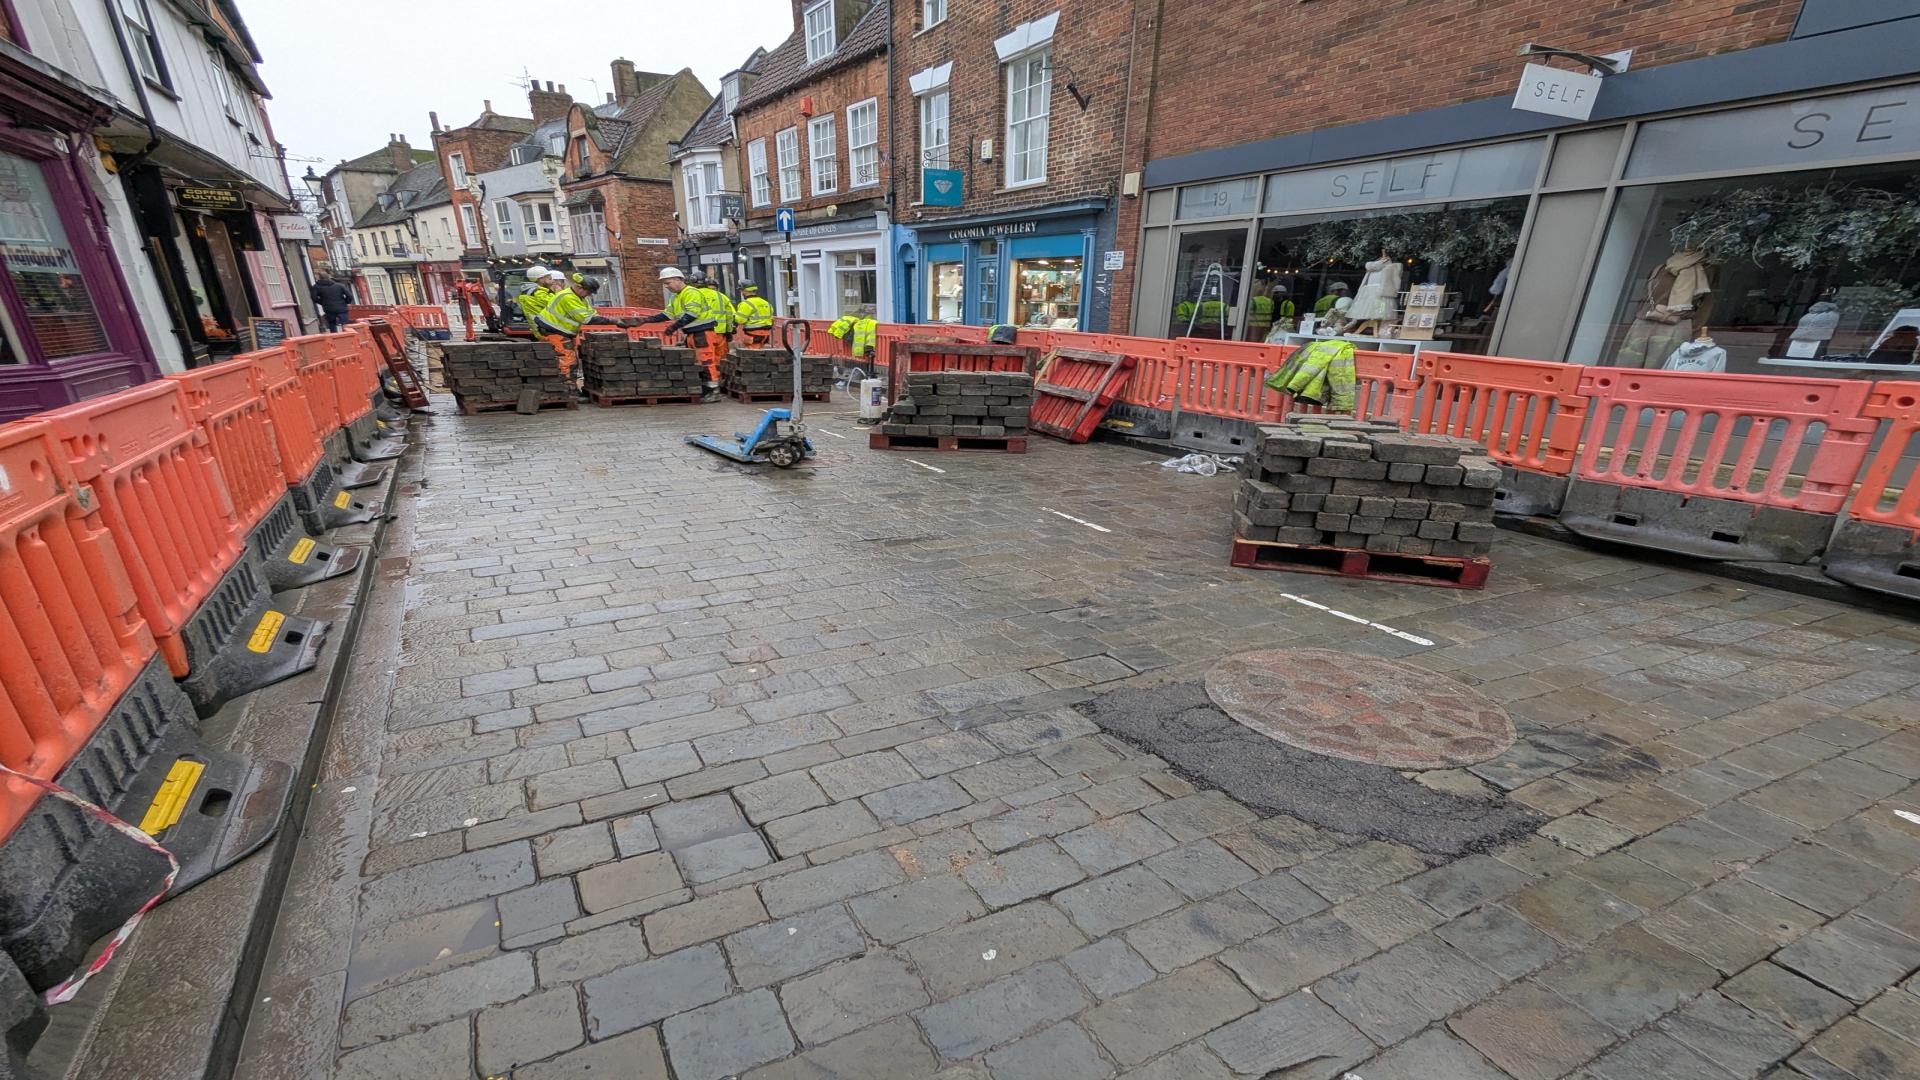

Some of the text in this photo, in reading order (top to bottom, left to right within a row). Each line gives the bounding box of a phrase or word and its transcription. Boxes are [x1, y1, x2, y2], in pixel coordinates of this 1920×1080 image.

[1533, 80, 1586, 105] SELF
[1330, 161, 1443, 199] SELF
[182, 193, 238, 202] CULTURE
[185, 188, 232, 197] COFFEE
[1212, 190, 1228, 207] 19
[948, 220, 1038, 240] COLONIA JEWELLERY
